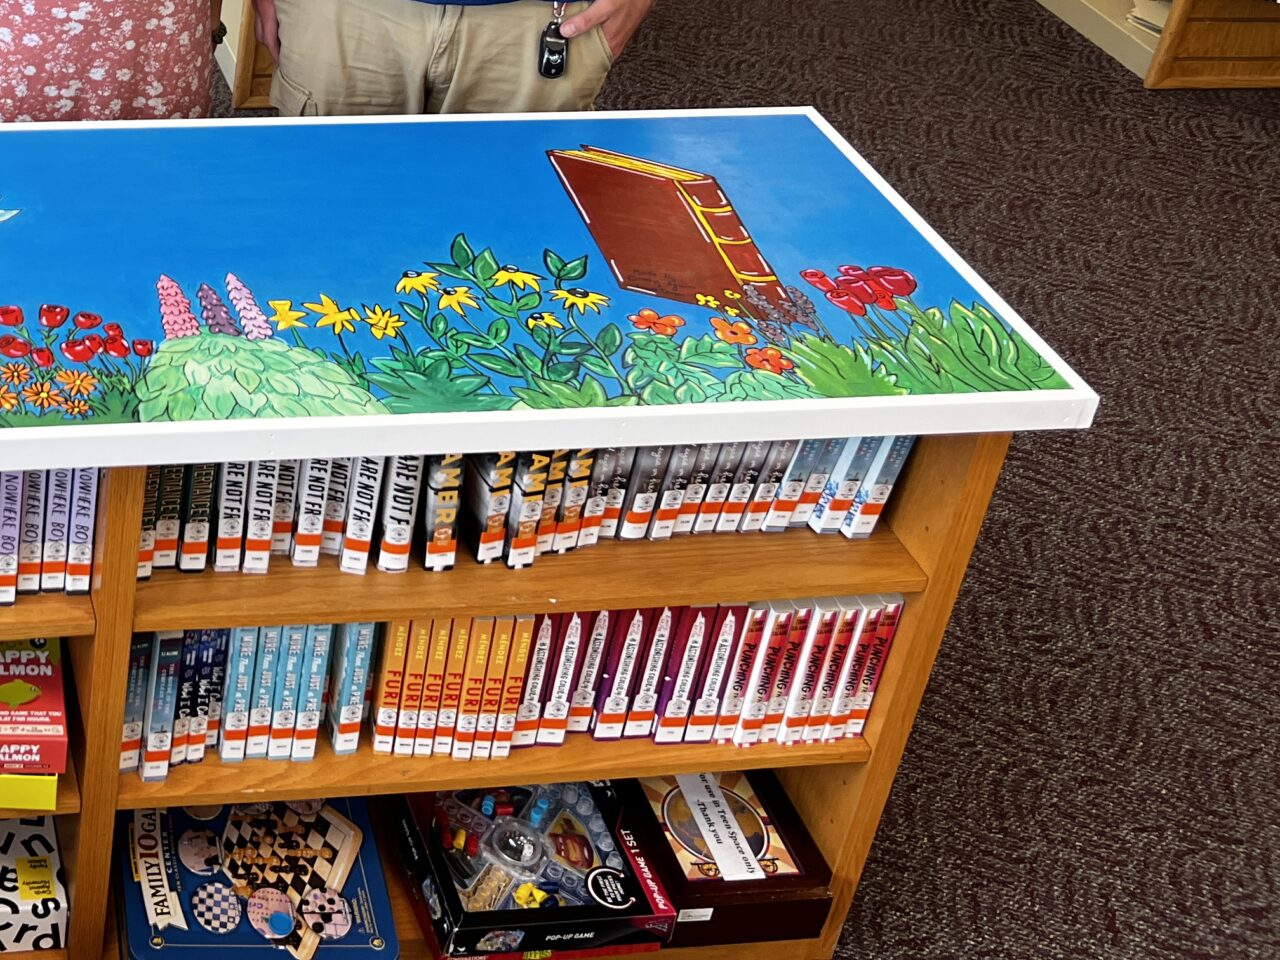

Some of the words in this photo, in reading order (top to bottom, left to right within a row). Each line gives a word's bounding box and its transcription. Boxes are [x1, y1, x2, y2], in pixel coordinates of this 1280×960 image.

[277, 464, 295, 489] NOT
[307, 475, 326, 499] NOT
[329, 461, 349, 488] NOT
[435, 453, 463, 524] AMER
[1, 473, 19, 529] NOWHERE
[225, 479, 243, 504] NOT
[254, 481, 273, 507] NOT
[355, 483, 375, 509] NOT
[391, 482, 415, 515] NOT
[313, 635, 327, 657] MORE
[357, 628, 370, 650] MORE
[733, 643, 758, 694] PUNCHING
[757, 646, 781, 696] PUNCHING
[776, 641, 800, 692] PUNCHING
[801, 645, 825, 694] PUNCHING
[822, 643, 846, 693] PUNCHING
[845, 643, 870, 694] PUNCHING
[862, 637, 887, 688] PUNCHING
[137, 833, 160, 860] 10
[620, 828, 637, 847] SET
[710, 828, 723, 845] you
[717, 810, 732, 833] Teen
[730, 832, 745, 855] Space
[743, 856, 756, 874] only
[162, 831, 173, 874] CENTER
[635, 856, 656, 883] GAME
[144, 860, 171, 917] FAMILY
[650, 879, 668, 910] POP-UP
[545, 933, 574, 941] POP-UP
